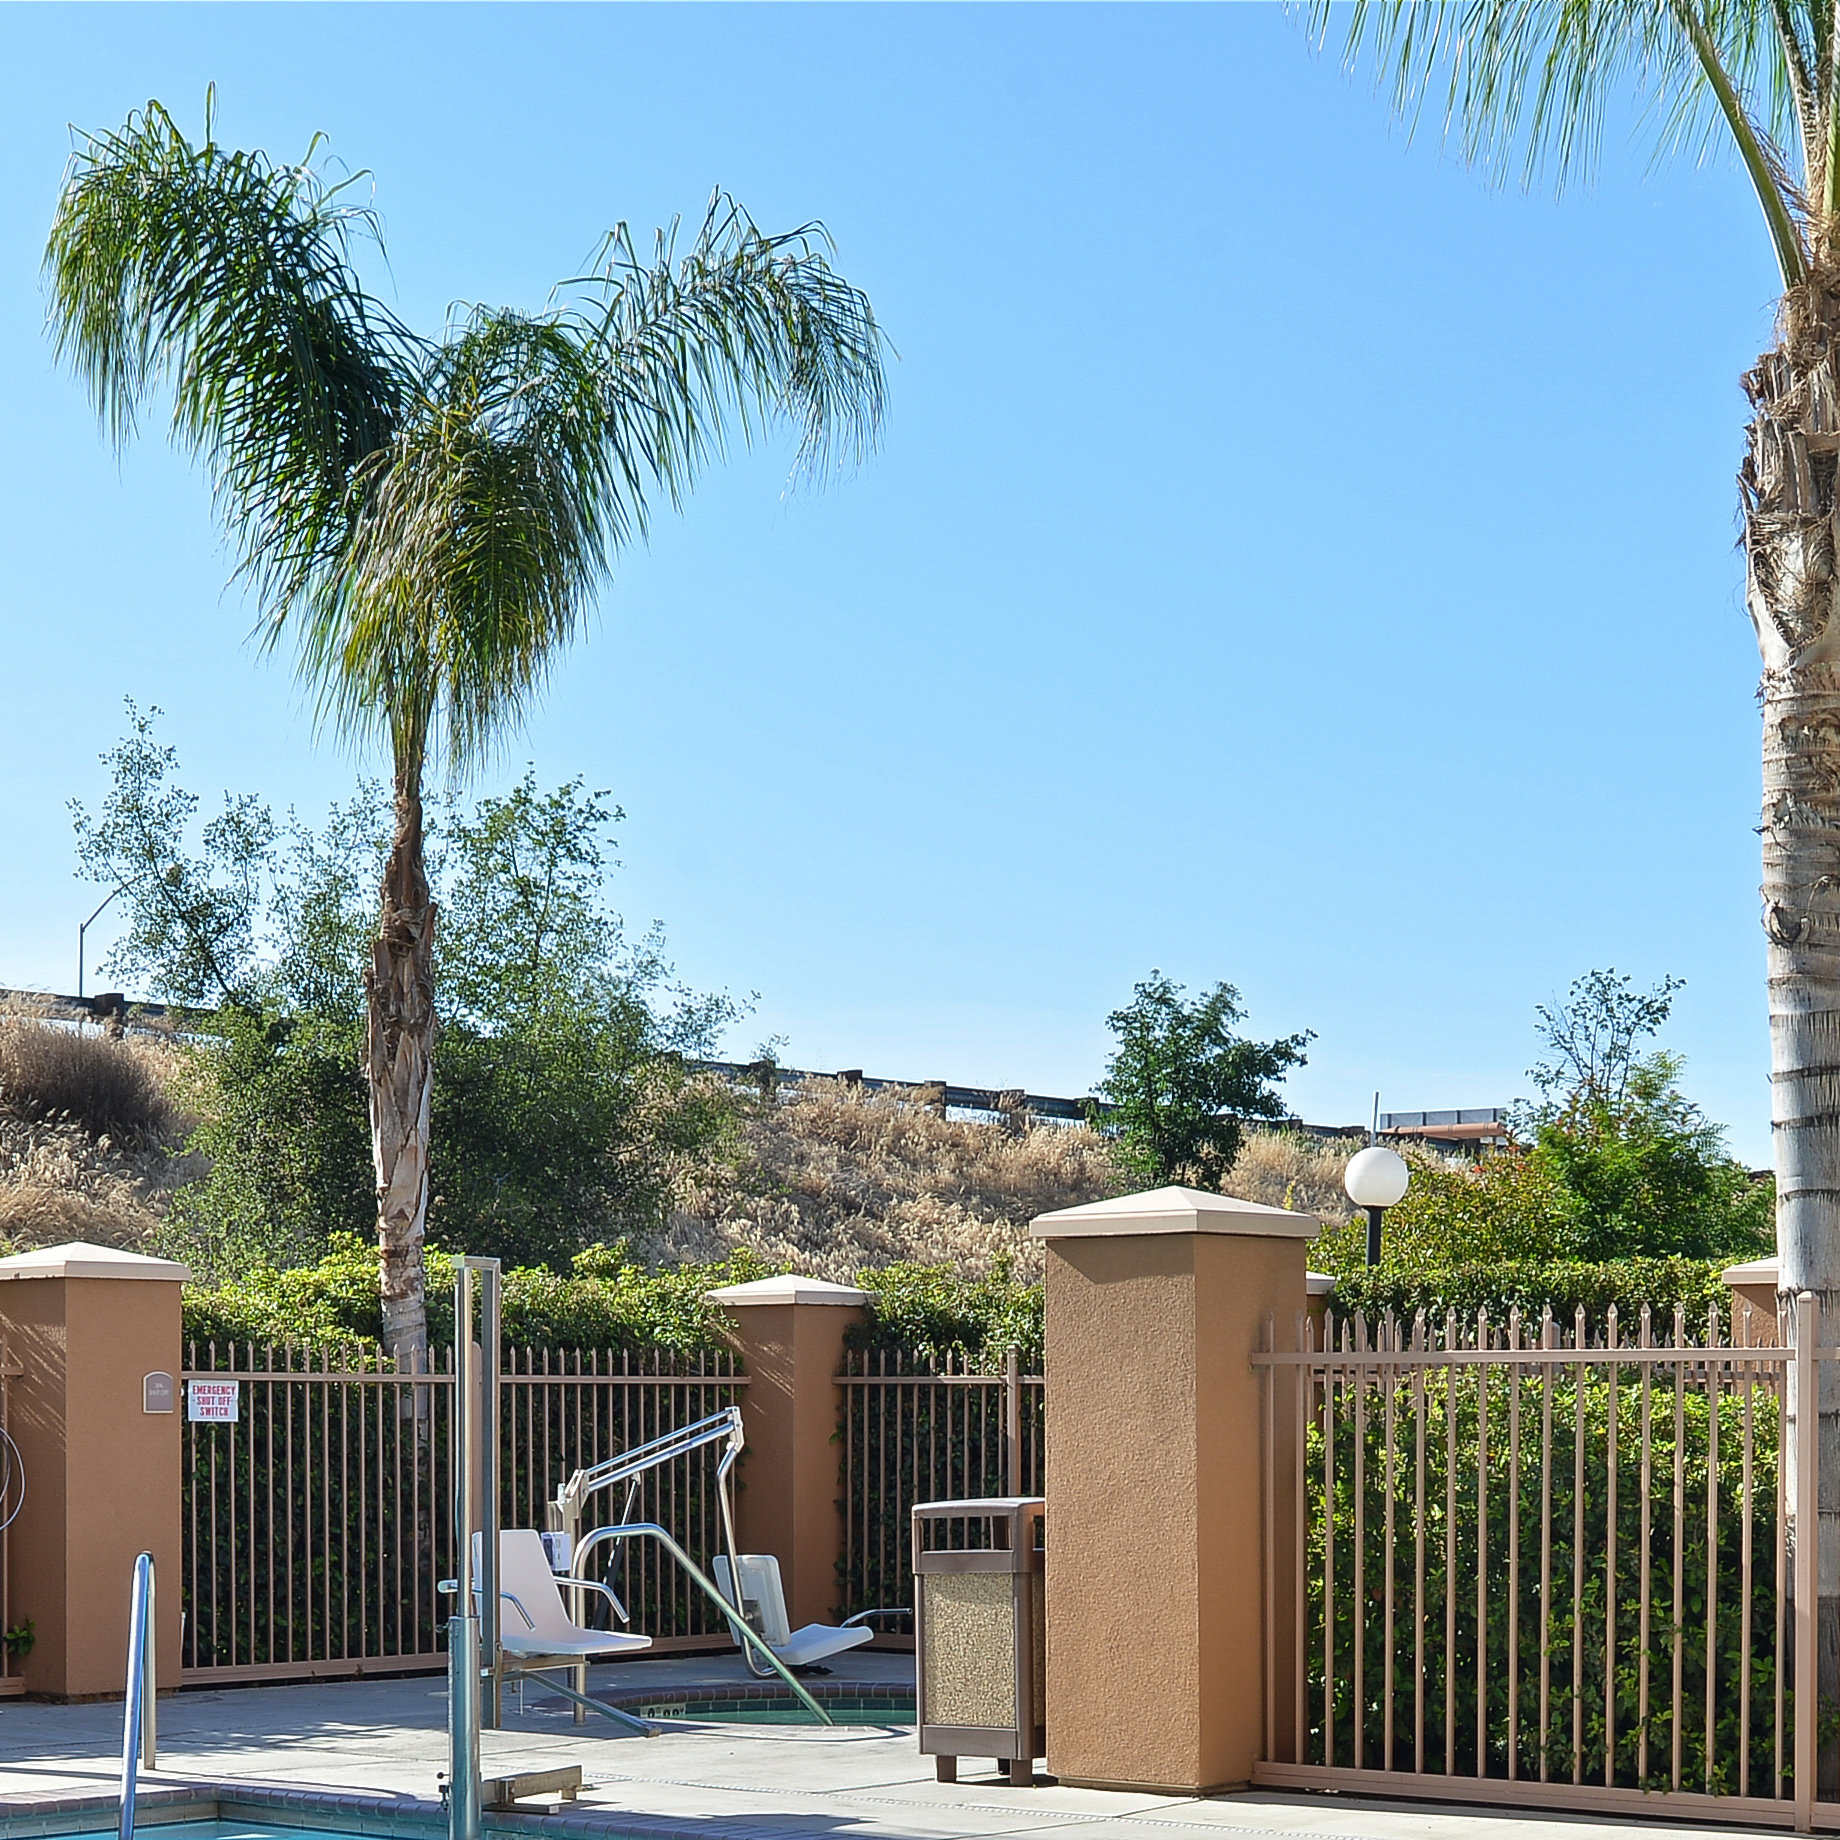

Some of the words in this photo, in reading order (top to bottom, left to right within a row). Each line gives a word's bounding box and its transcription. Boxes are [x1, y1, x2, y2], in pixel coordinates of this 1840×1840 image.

[192, 1384, 236, 1395] EMERGENCY
[196, 1396, 216, 1405] SHUT
[217, 1396, 232, 1405] OFF
[199, 1406, 229, 1417] SWITCH
